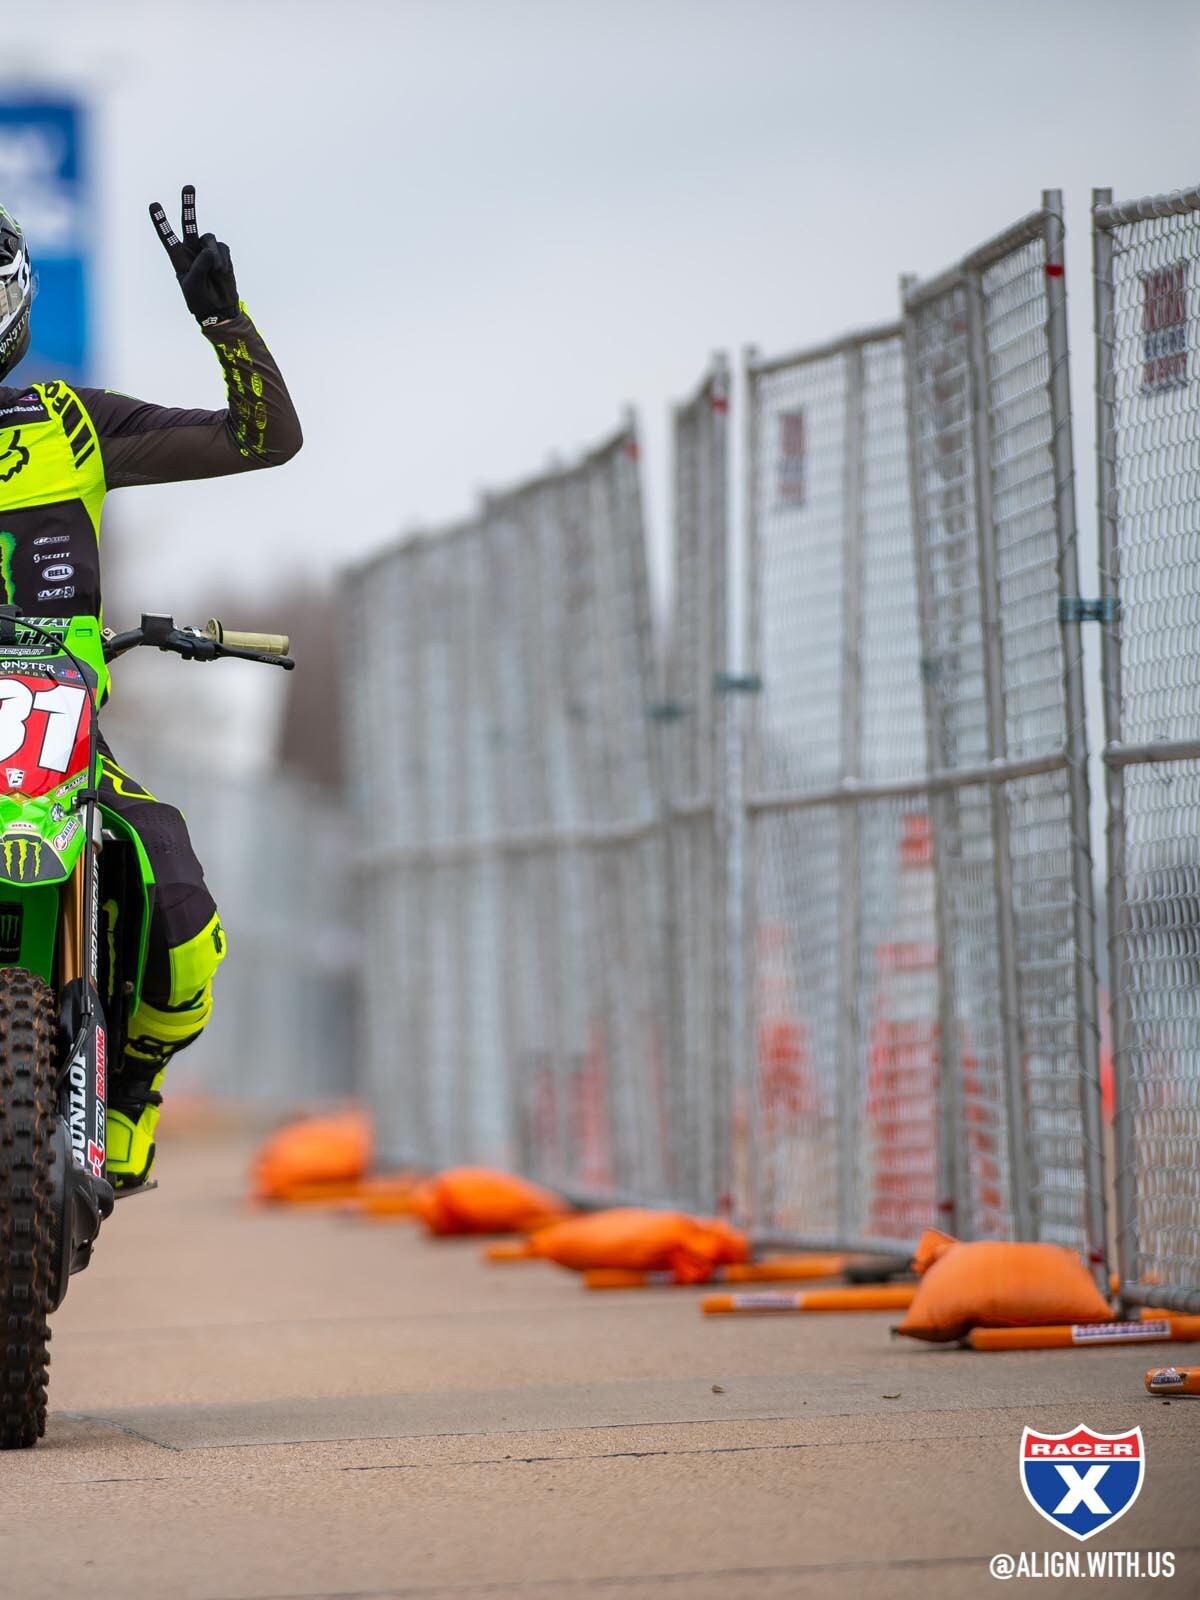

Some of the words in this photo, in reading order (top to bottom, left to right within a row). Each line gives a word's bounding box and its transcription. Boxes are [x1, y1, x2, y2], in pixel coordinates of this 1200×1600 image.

[41, 552, 70, 561] SCOTT
[48, 568, 70, 578] BELL
[0, 669, 46, 678] ENERGY
[96, 1025, 105, 1101] BRAKING
